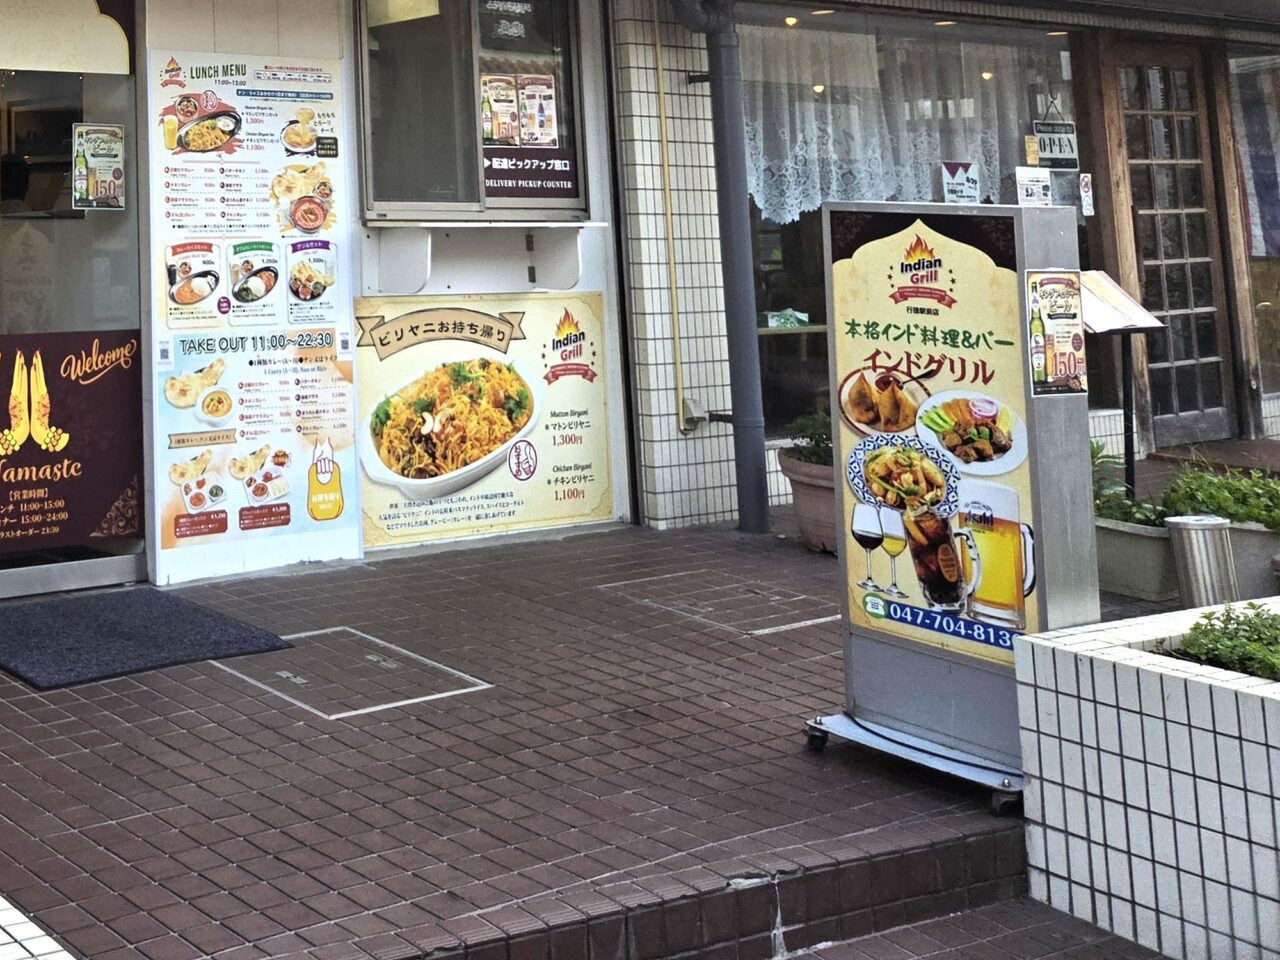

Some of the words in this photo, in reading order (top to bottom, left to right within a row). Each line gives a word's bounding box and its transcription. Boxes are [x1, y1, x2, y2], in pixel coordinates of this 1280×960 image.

[190, 64, 219, 80] LUNCH
[222, 64, 247, 77] MENU
[485, 179, 516, 187] DELIVERY
[518, 179, 542, 188] PICKUP
[543, 180, 572, 188] COUNTER
[900, 258, 942, 273] Indian
[910, 270, 938, 284] Grill
[378, 319, 506, 347] ビリヤニお持ち帰り
[551, 331, 586, 352] Indian
[844, 318, 1015, 350] 本格インド料理&バー
[179, 337, 215, 355] TAKE
[223, 336, 248, 351] OUT
[560, 344, 583, 362] Grill
[60, 338, 138, 385] Welcome
[863, 347, 996, 386] インドグリル
[1053, 351, 1077, 378] 150
[551, 420, 592, 431] マトンビリヤニ
[552, 433, 583, 447] 1,300円
[553, 474, 595, 486] チキンビリヤニ
[554, 488, 585, 501] 1,100円
[0, 528, 40, 539] ラストオーダー
[889, 601, 1020, 647] 047-704-813
